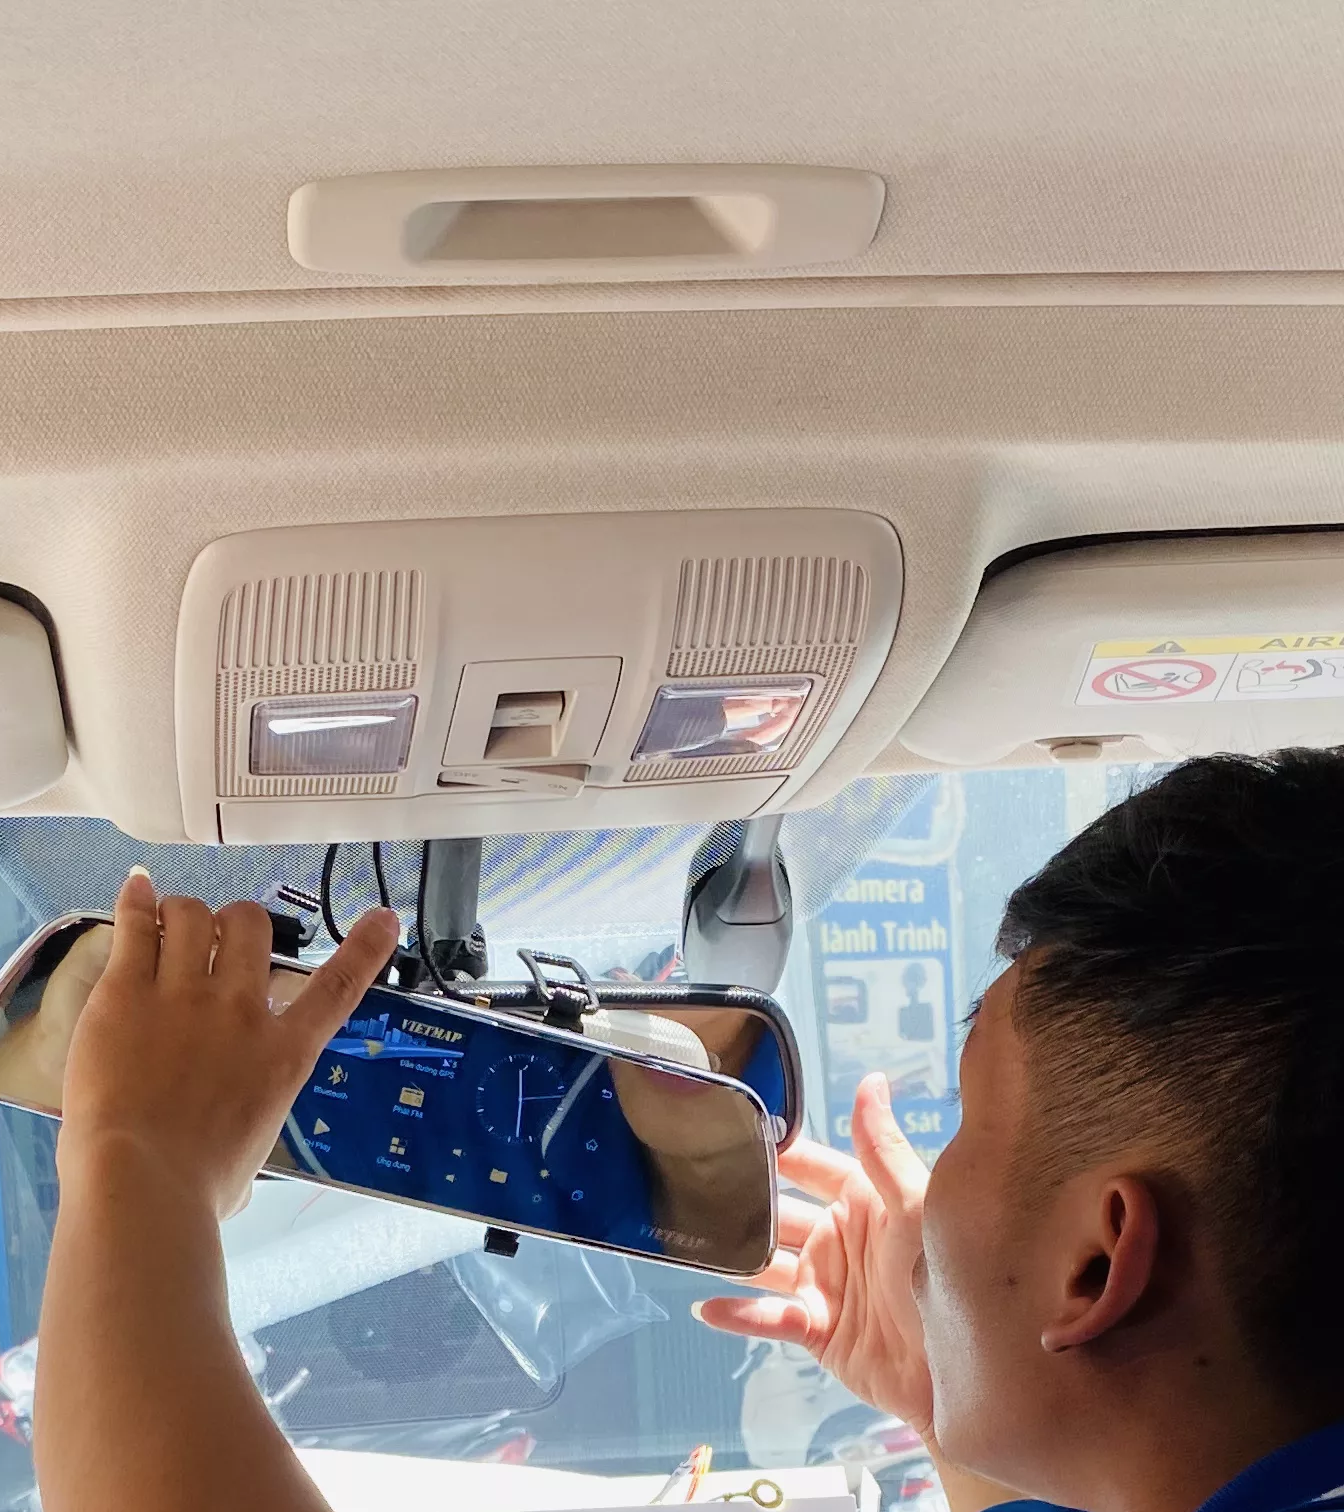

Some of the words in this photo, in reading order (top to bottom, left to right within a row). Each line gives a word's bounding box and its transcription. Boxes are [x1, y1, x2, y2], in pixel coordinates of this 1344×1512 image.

[839, 878, 925, 904] amera
[880, 917, 947, 952] Trình
[401, 1018, 463, 1043] VIETMAP
[904, 1111, 943, 1134] Sát
